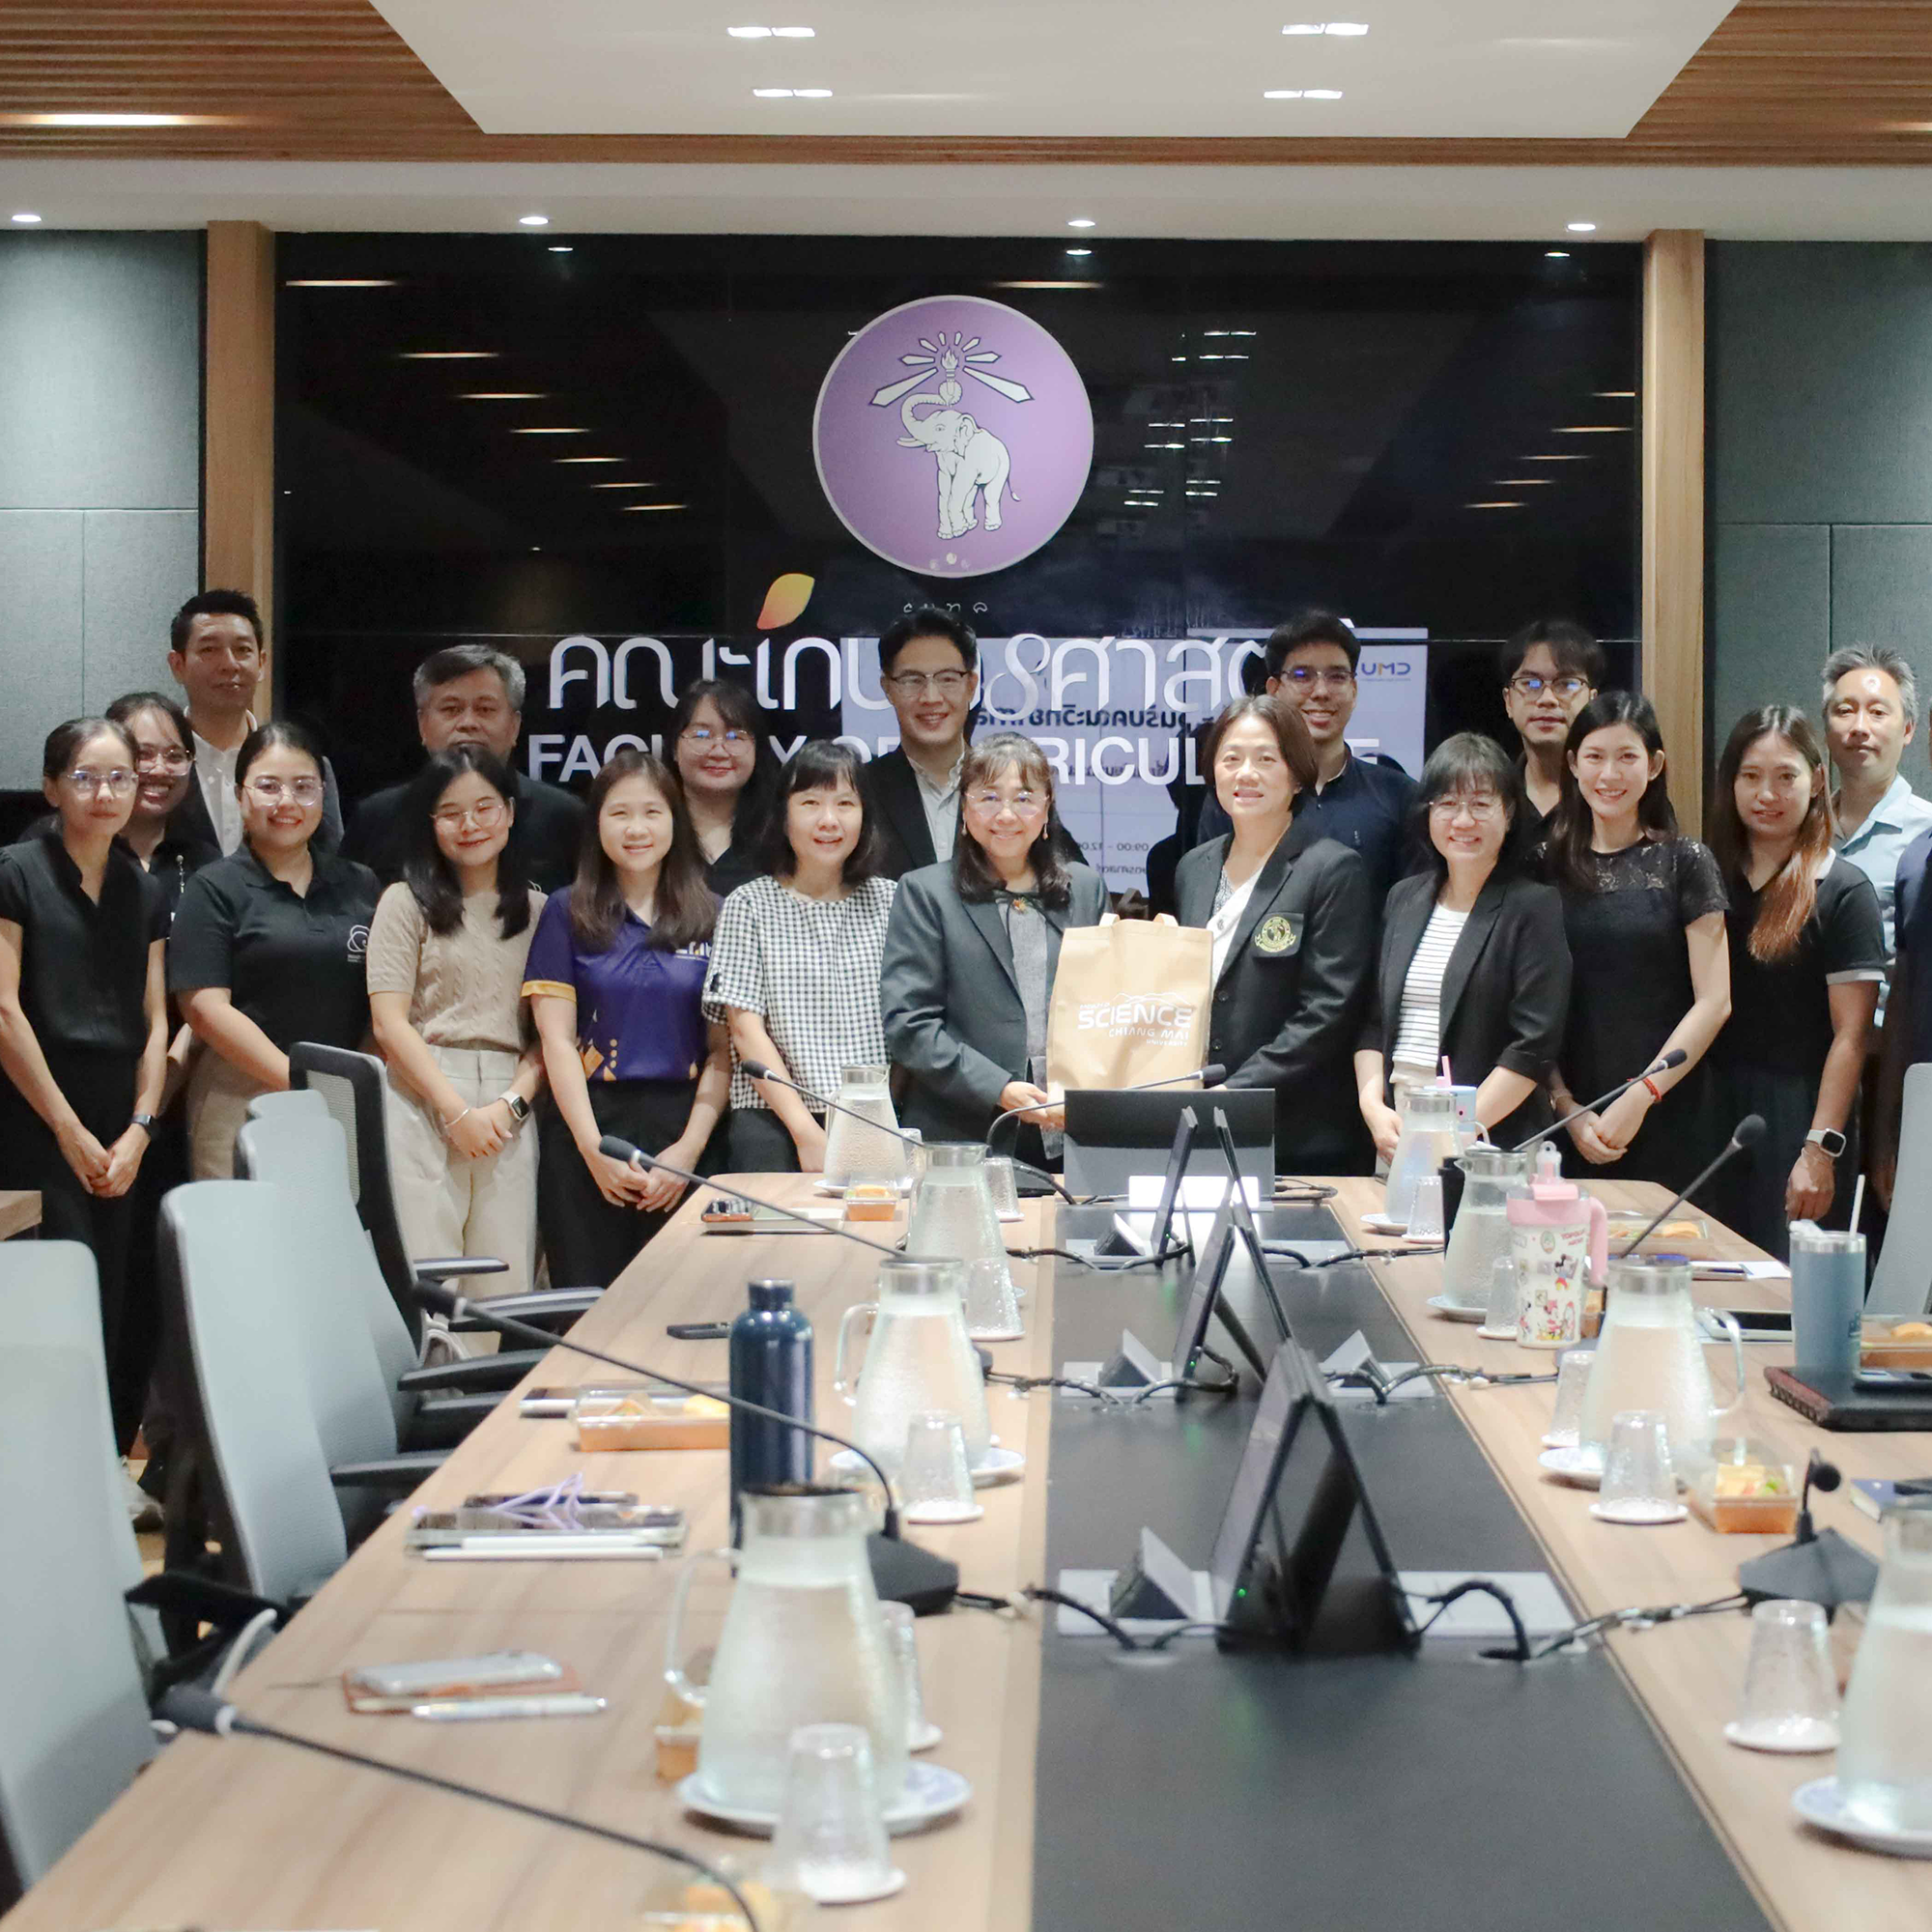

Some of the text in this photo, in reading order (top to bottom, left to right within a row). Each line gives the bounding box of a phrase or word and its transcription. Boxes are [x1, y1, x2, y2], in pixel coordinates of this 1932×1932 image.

[1077, 1003, 1192, 1030] SCIENCE
[1109, 1027, 1189, 1040] CHIANG MAI
